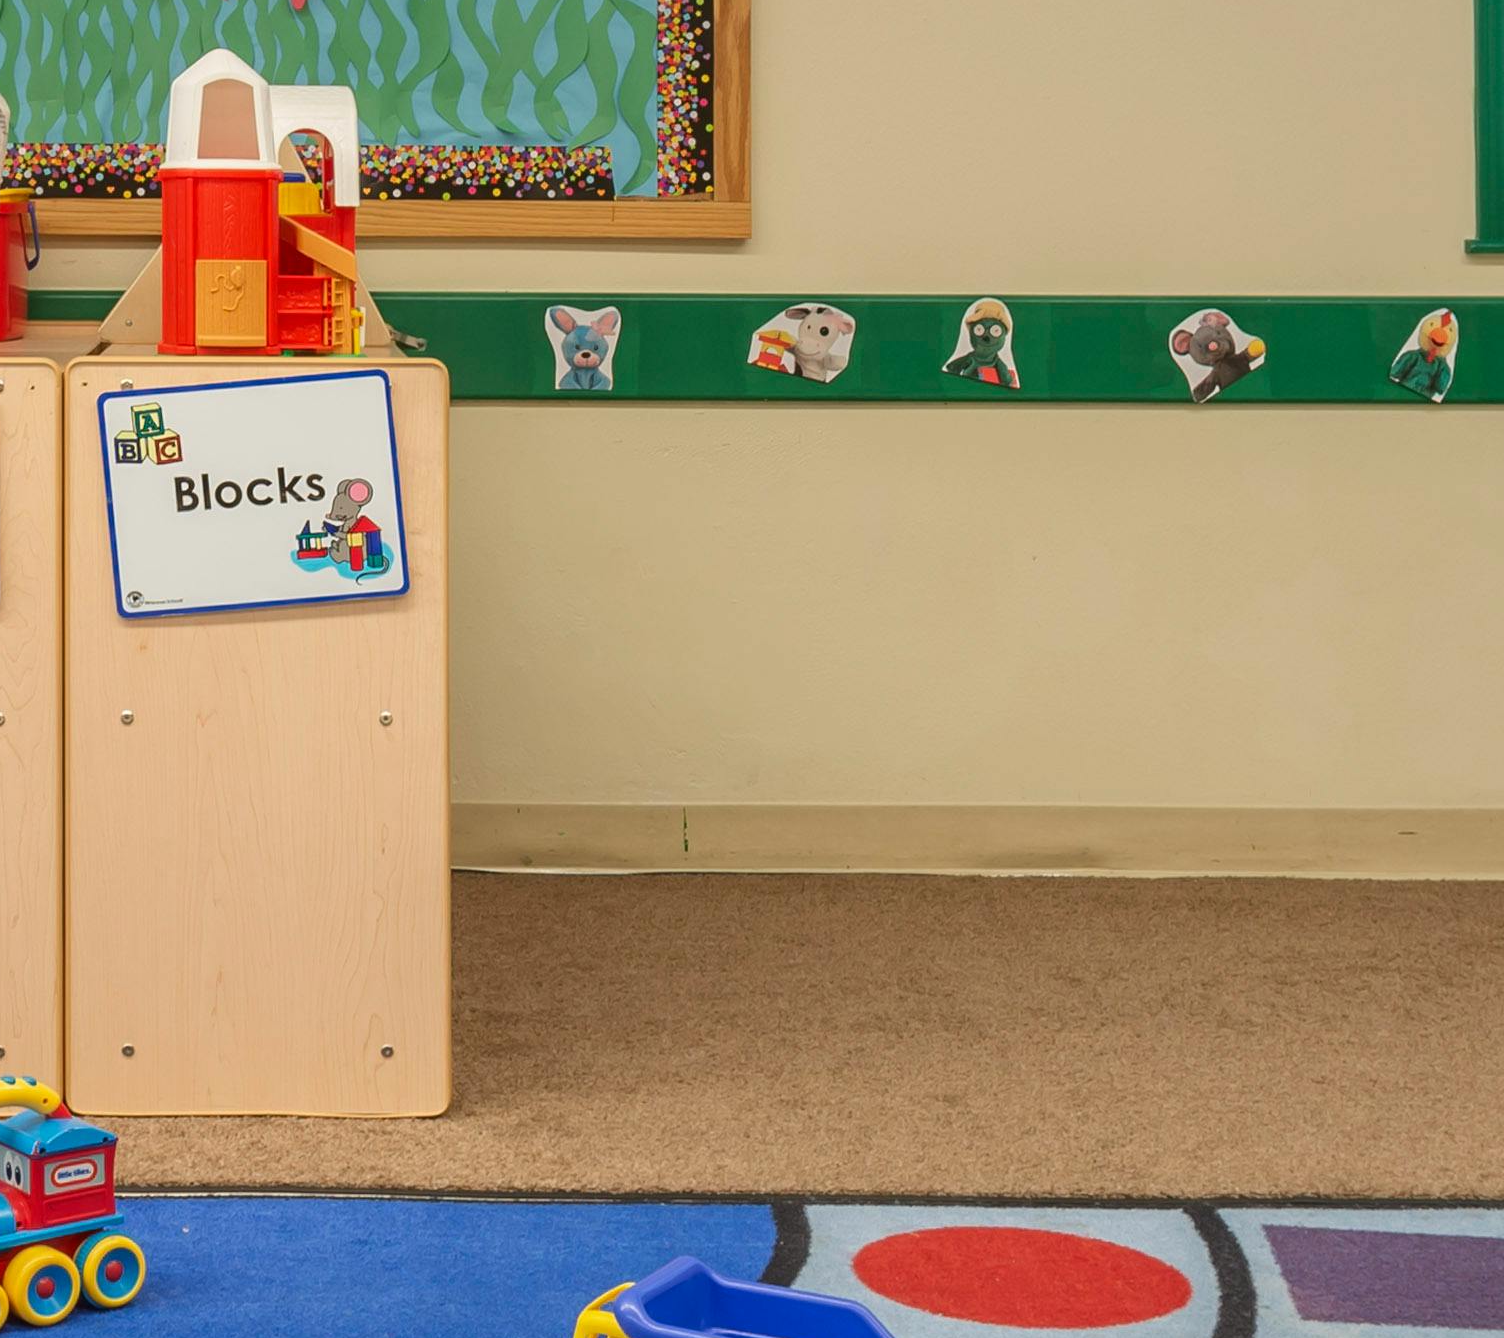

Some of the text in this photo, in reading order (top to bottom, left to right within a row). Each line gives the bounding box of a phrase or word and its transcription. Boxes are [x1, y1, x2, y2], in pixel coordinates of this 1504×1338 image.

[141, 413, 161, 433] A
[120, 443, 136, 460] B
[160, 441, 177, 459] C
[174, 466, 326, 513] Blocks
